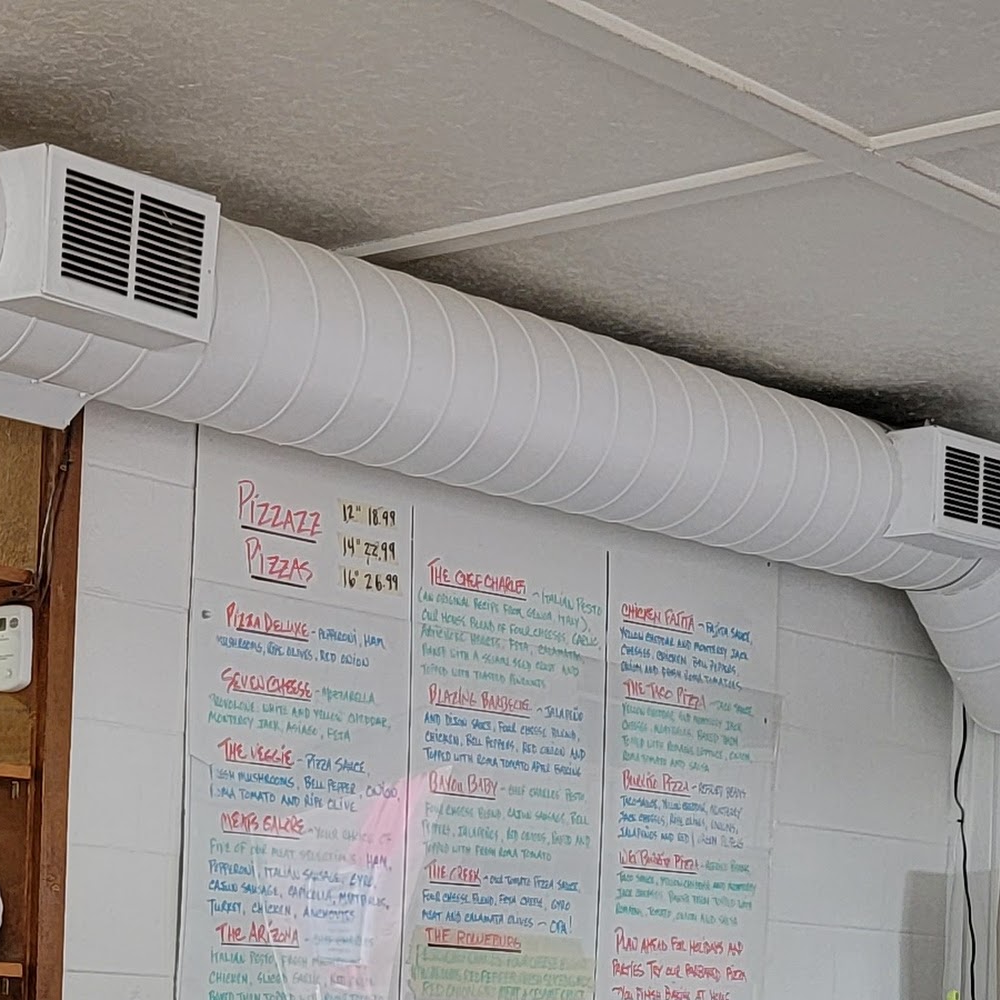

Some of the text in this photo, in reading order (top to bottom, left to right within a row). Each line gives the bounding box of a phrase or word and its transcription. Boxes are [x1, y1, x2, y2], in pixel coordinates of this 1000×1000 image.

[238, 480, 322, 537] PIZZAZZ
[369, 507, 396, 526] 18.99
[245, 537, 313, 582] PIZZAS
[364, 542, 395, 561] 22.99
[364, 574, 398, 591] 26.99
[428, 557, 451, 586] THE
[226, 601, 261, 629] PIZZA
[264, 611, 310, 637] DELUXE
[622, 602, 661, 622] CHICKEN
[221, 668, 313, 698] SEVEN CHEESE
[623, 678, 645, 697] THE
[218, 737, 247, 760] THE
[250, 744, 295, 766] VEGGIE
[305, 753, 332, 771] PIZZA
[467, 773, 499, 796] BABY
[221, 811, 259, 832] MEATS
[424, 859, 446, 880] THE
[216, 922, 246, 942] THE
[249, 921, 299, 944] ARIZONA
[425, 927, 450, 942] THE
[614, 926, 638, 954] PLAN
